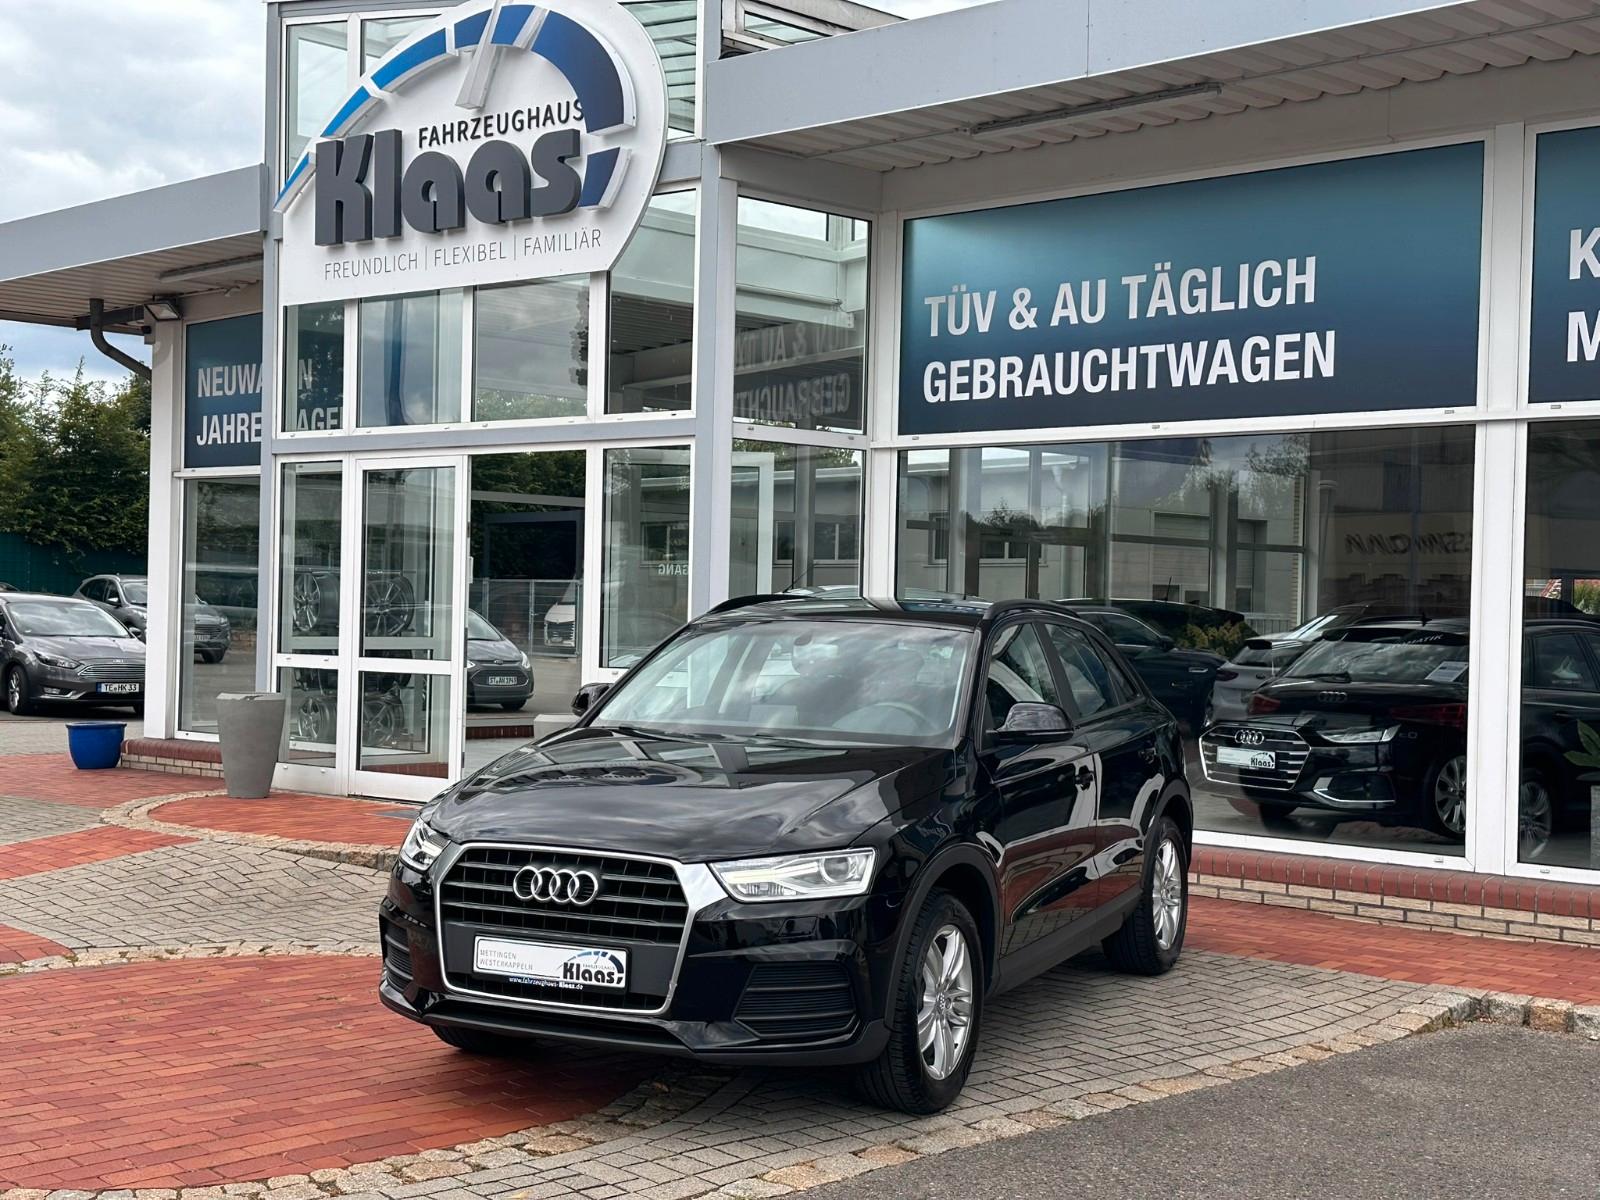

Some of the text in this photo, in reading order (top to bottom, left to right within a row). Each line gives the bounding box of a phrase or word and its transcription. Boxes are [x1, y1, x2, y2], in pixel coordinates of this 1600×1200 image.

[418, 99, 584, 149] FAHRZEUGHAUS
[315, 129, 582, 246] Klaas
[324, 227, 601, 280] FREUNDLICH FLEXIBEL FAMILIÄR
[924, 256, 1316, 338] TÜV & AU TÄGLICH
[923, 330, 1336, 403] GEBRAUCHTWAGEN
[480, 949, 516, 960] METTINGEN
[563, 962, 615, 984] Klaas
